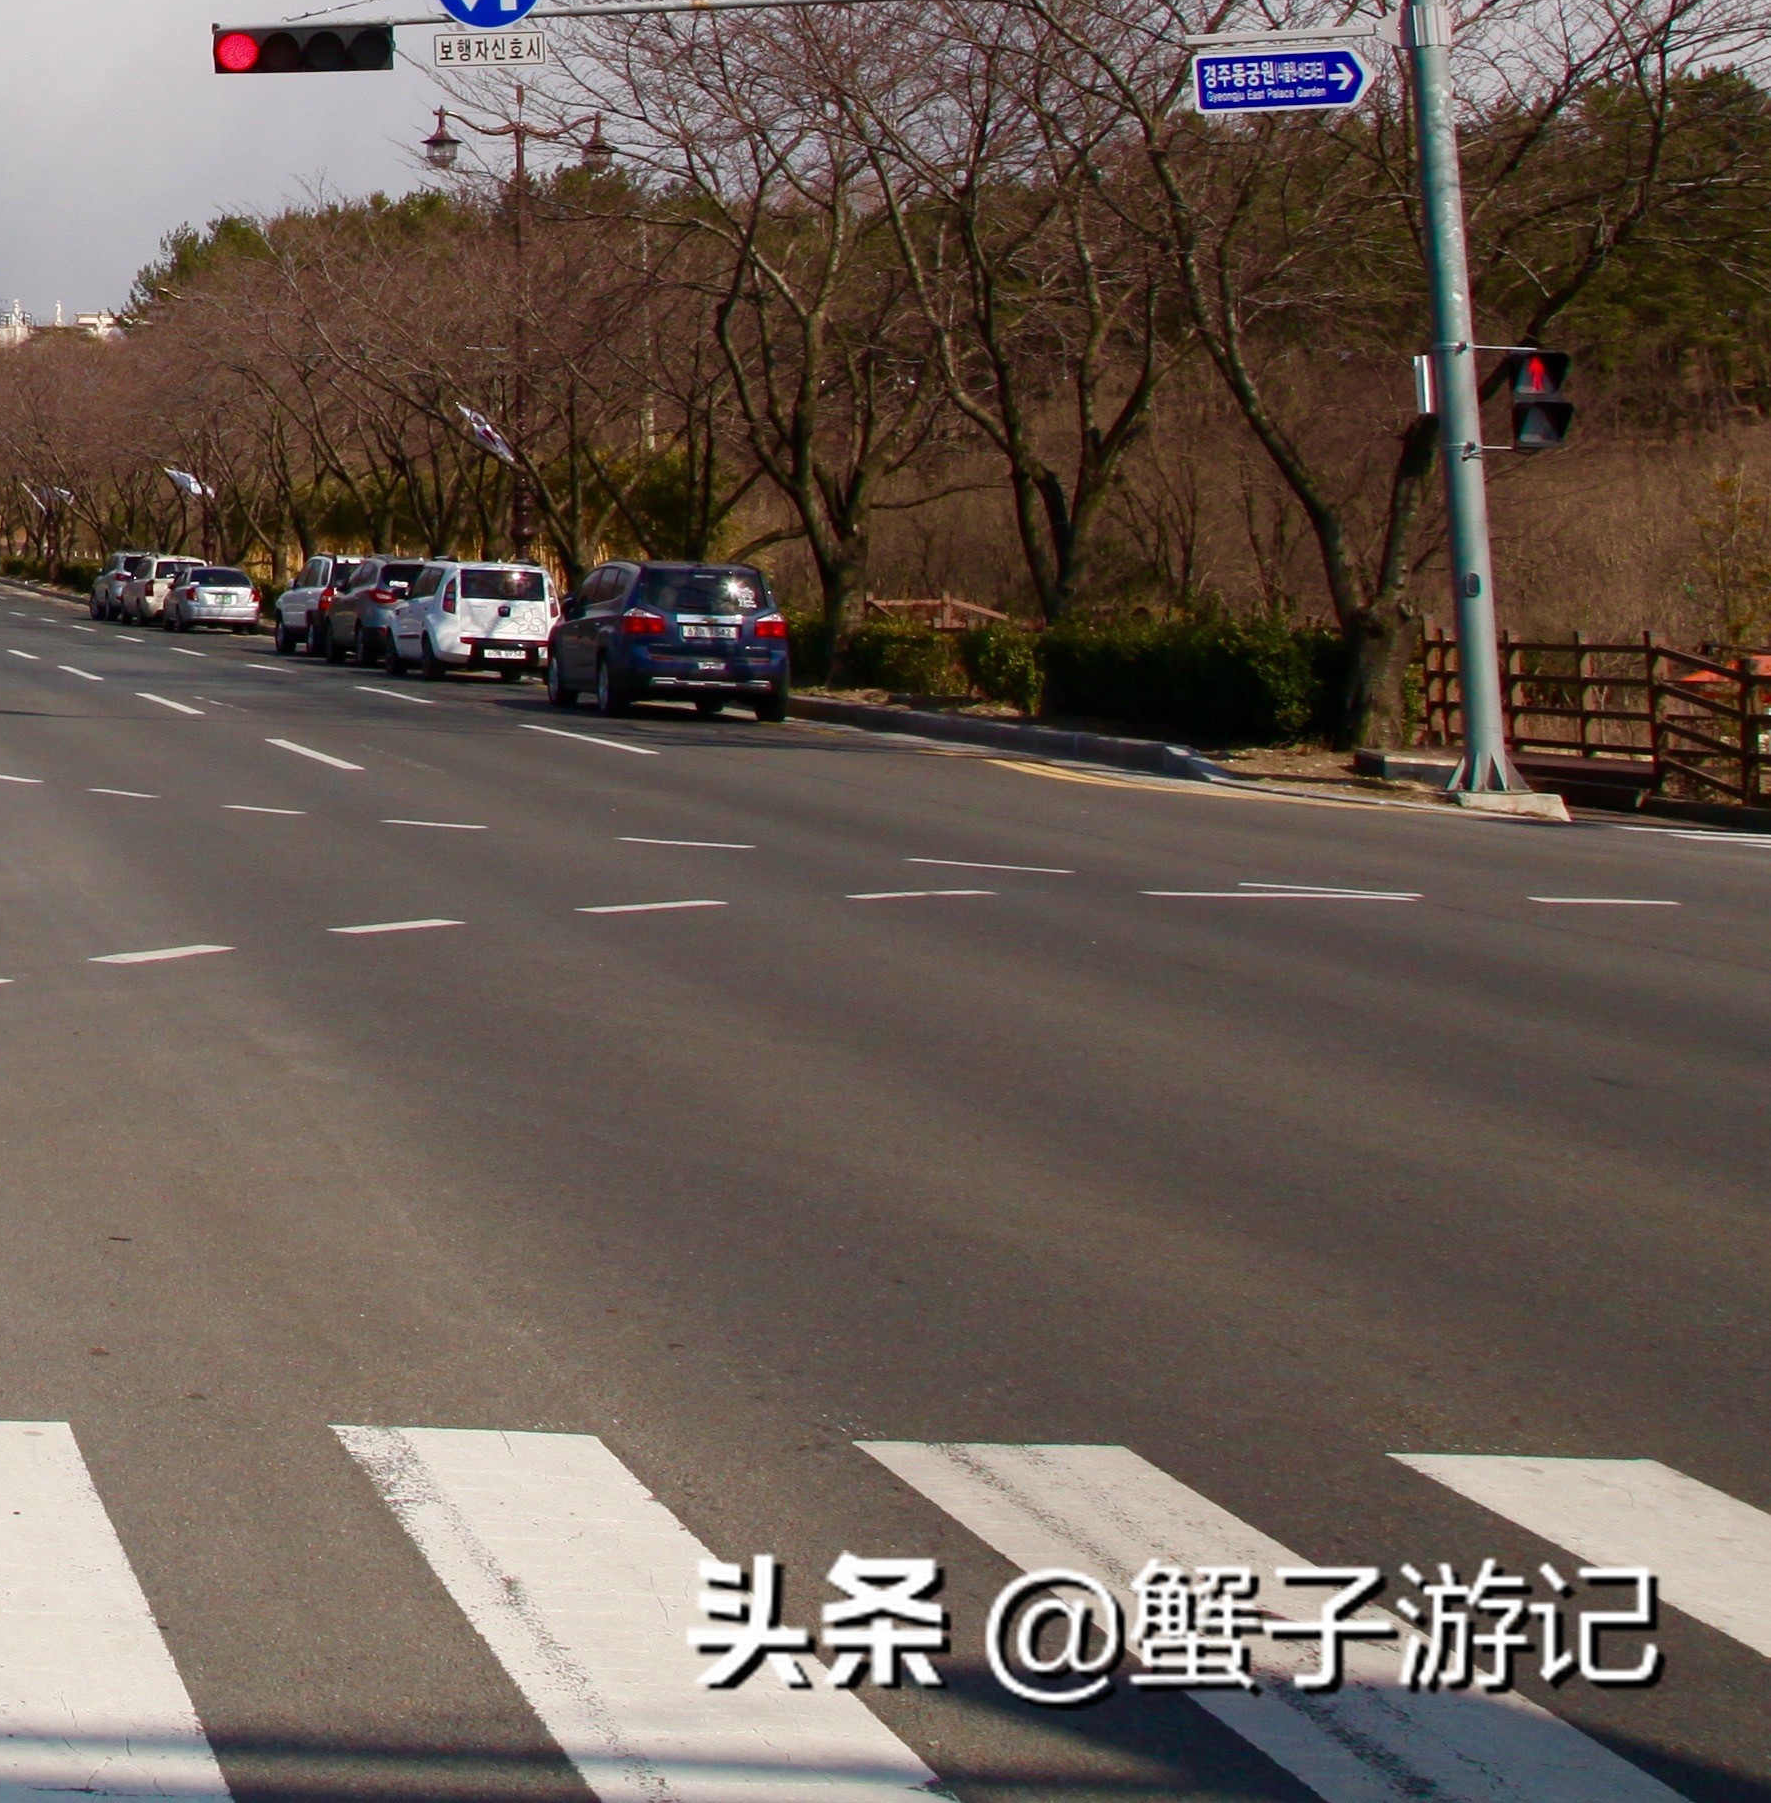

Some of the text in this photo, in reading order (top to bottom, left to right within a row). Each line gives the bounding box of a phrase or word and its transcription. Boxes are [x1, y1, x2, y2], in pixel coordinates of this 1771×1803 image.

[439, 37, 541, 61] 보행자신호시
[1203, 61, 1275, 88] 경주동궁원
[1247, 89, 1266, 100] East
[1267, 88, 1295, 99] Palace
[1296, 86, 1326, 98] Garden
